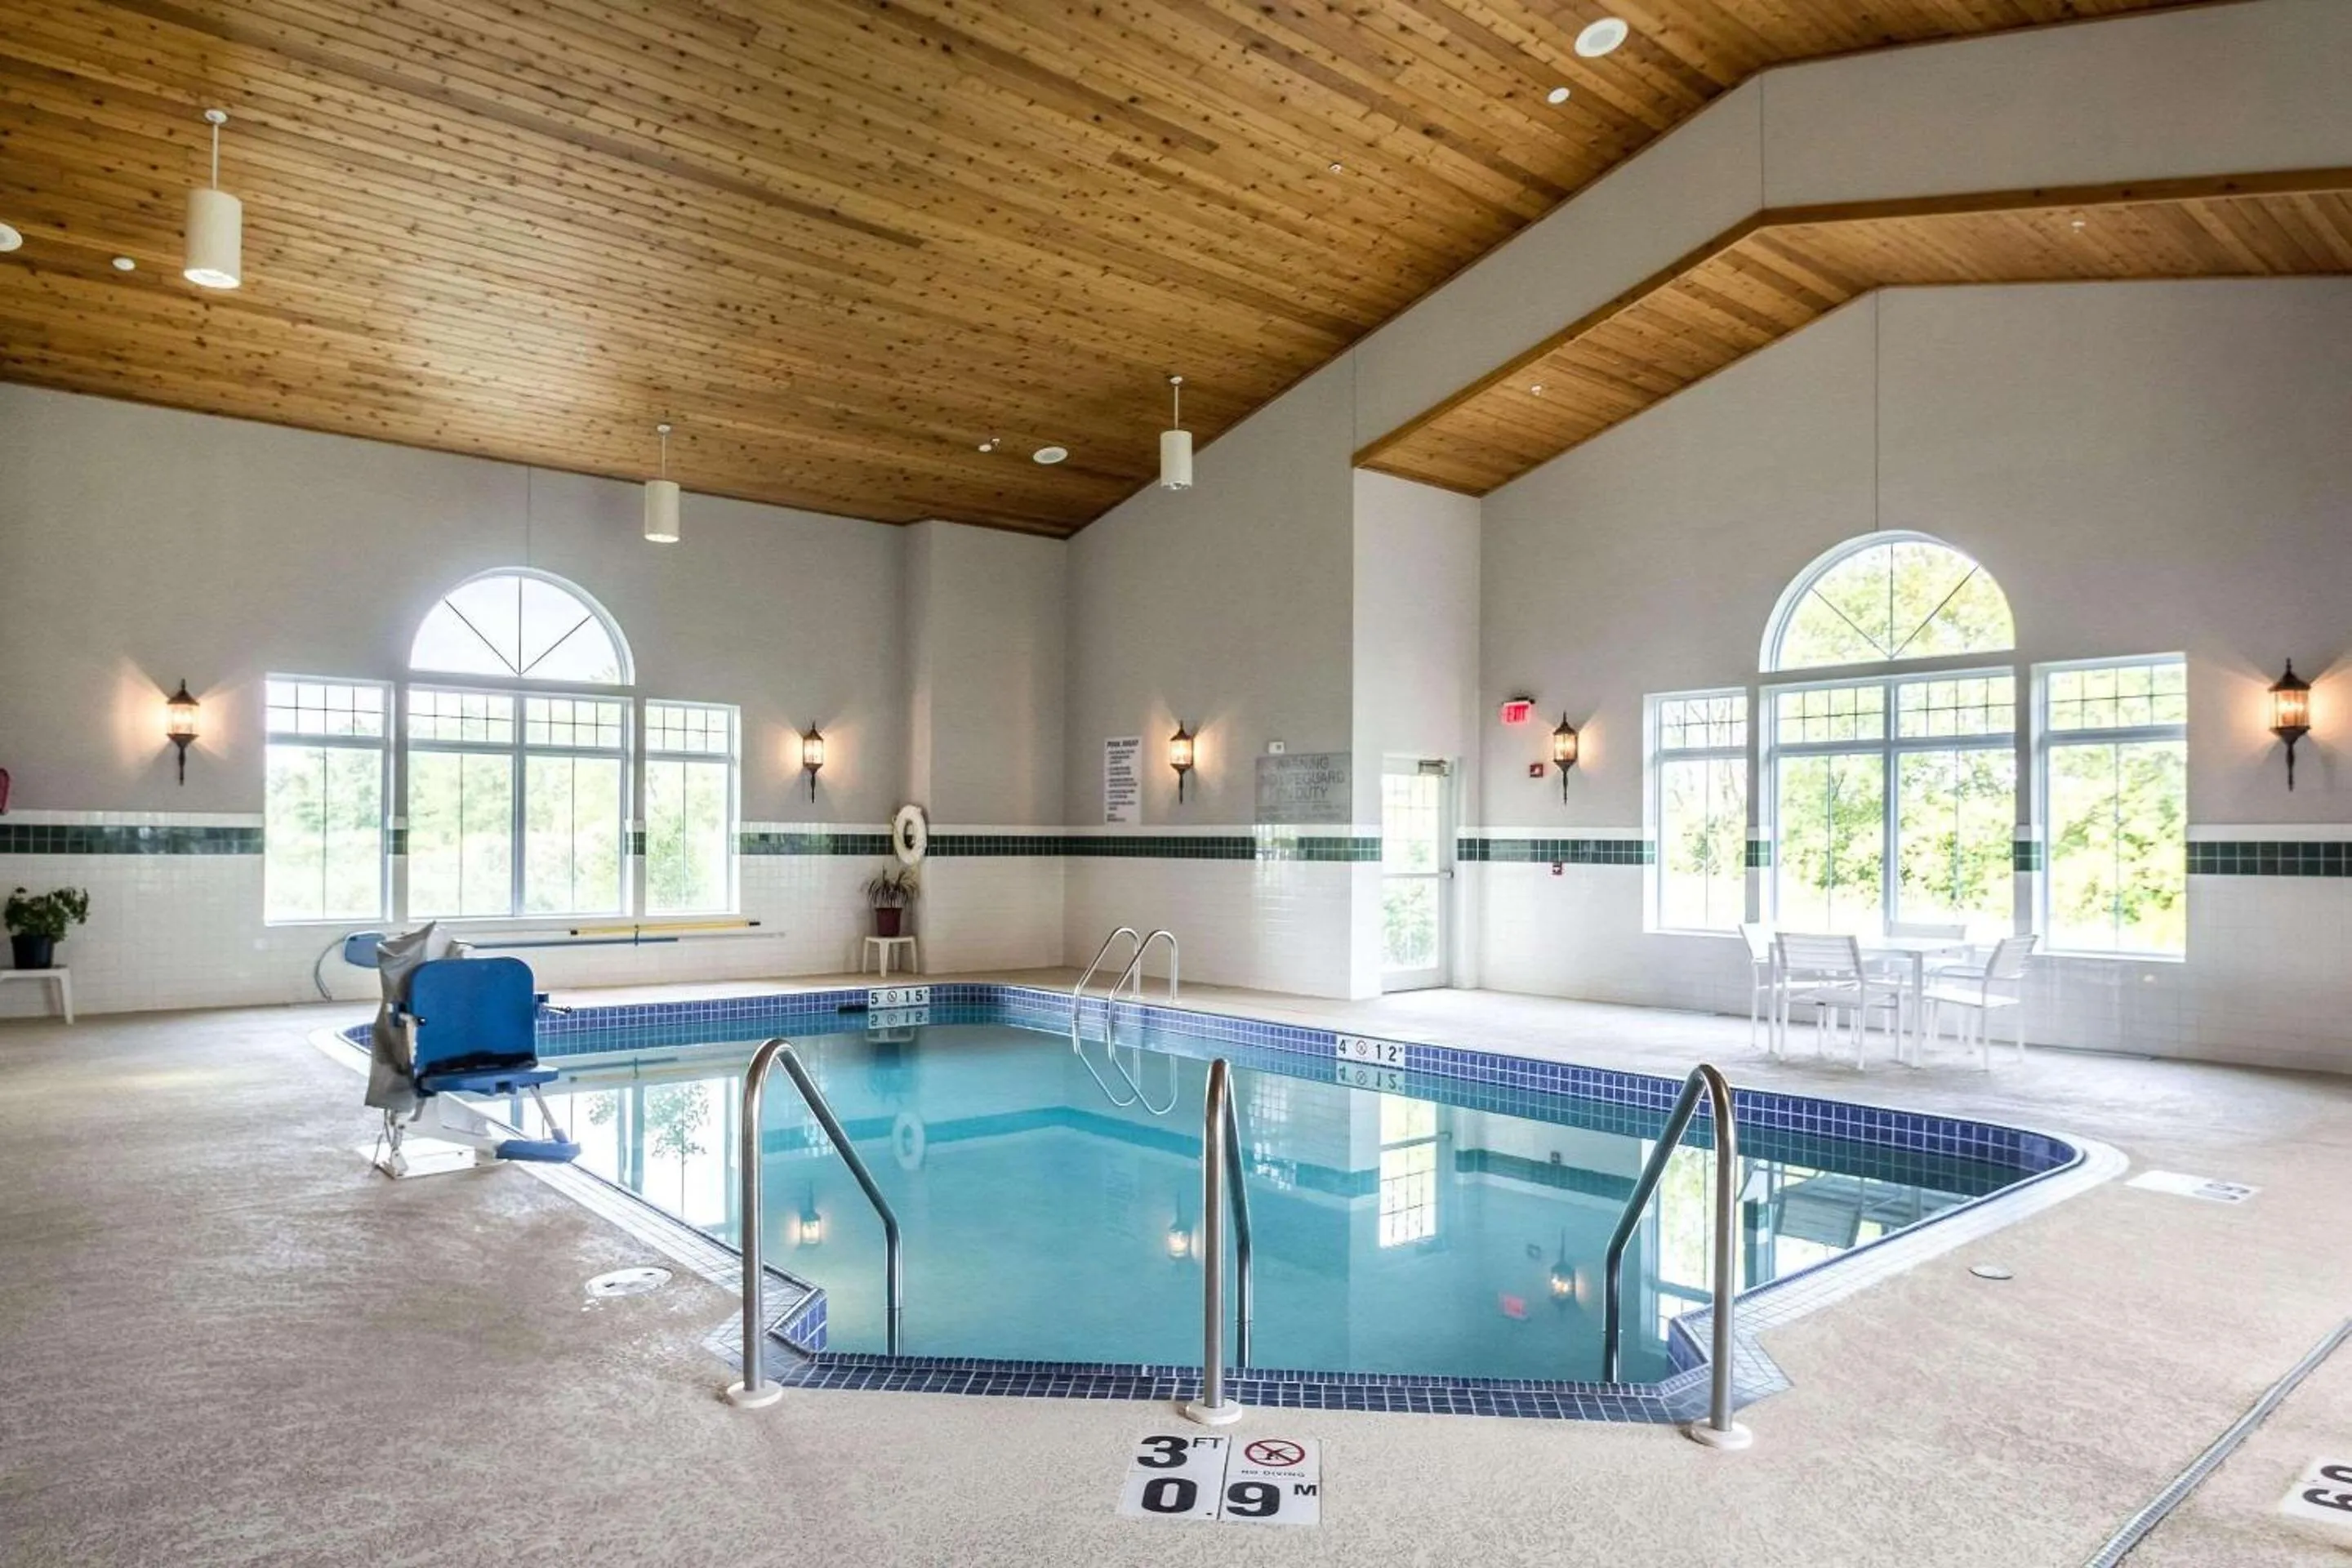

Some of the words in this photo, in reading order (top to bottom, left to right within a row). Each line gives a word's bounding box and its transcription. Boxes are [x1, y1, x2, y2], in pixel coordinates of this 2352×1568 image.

[1138, 1436, 1188, 1468] 3
[1192, 1437, 1223, 1448] FT
[1294, 1484, 1317, 1496] M
